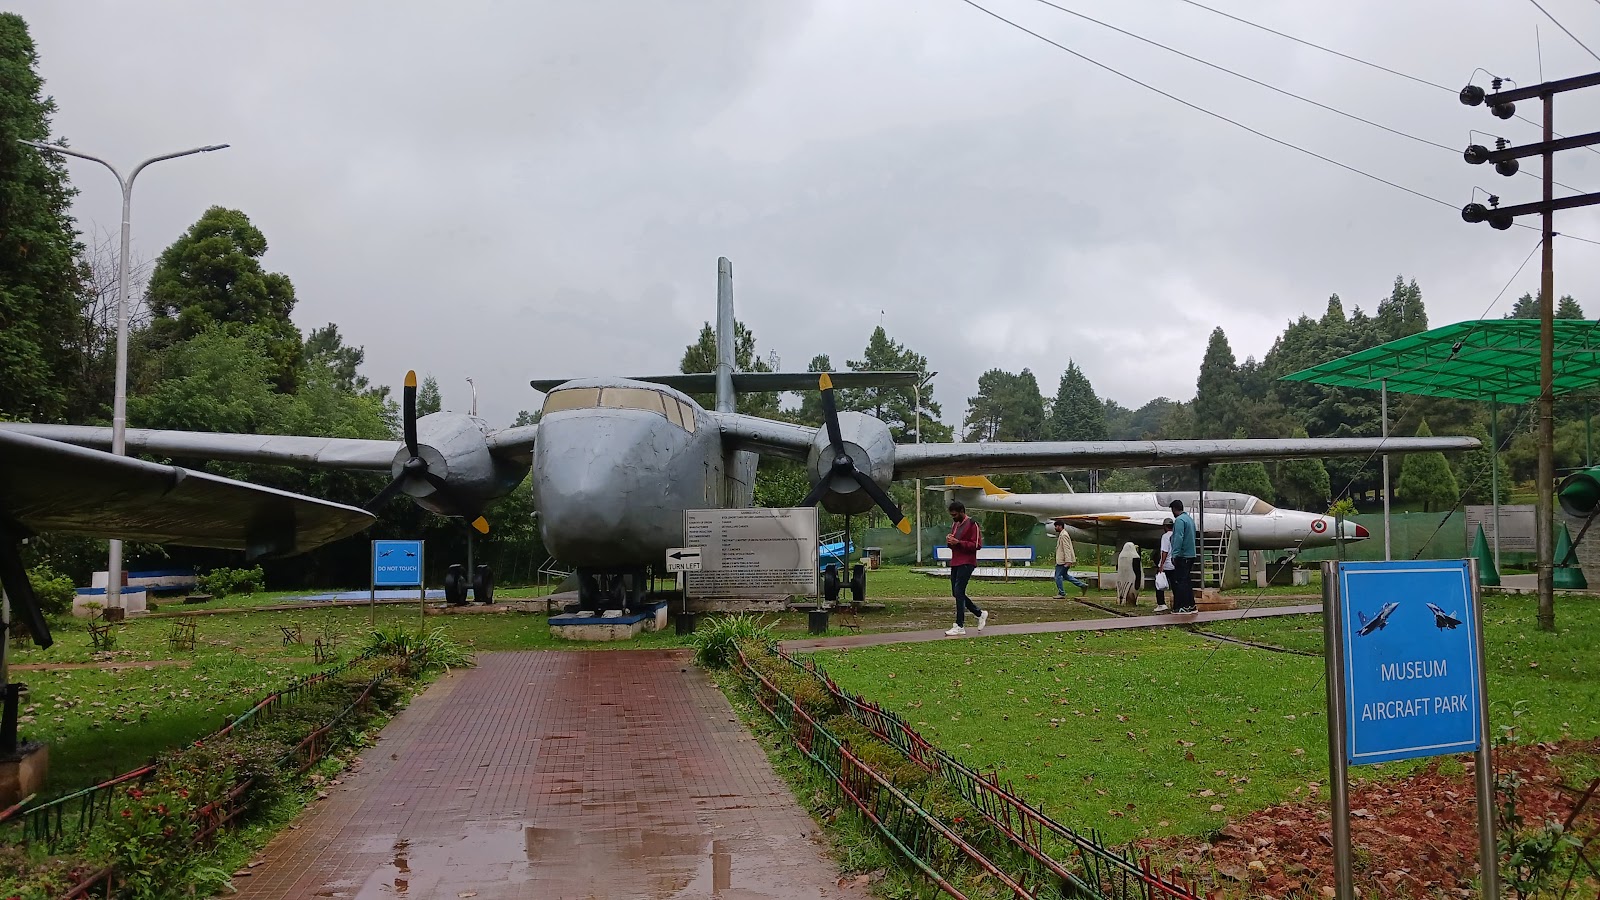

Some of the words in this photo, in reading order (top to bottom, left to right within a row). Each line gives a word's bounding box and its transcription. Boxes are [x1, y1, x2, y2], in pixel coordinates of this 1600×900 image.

[1381, 660, 1447, 681] MUSEUM
[1361, 698, 1430, 721] AIRCRAFT
[1434, 694, 1468, 714] PARK
